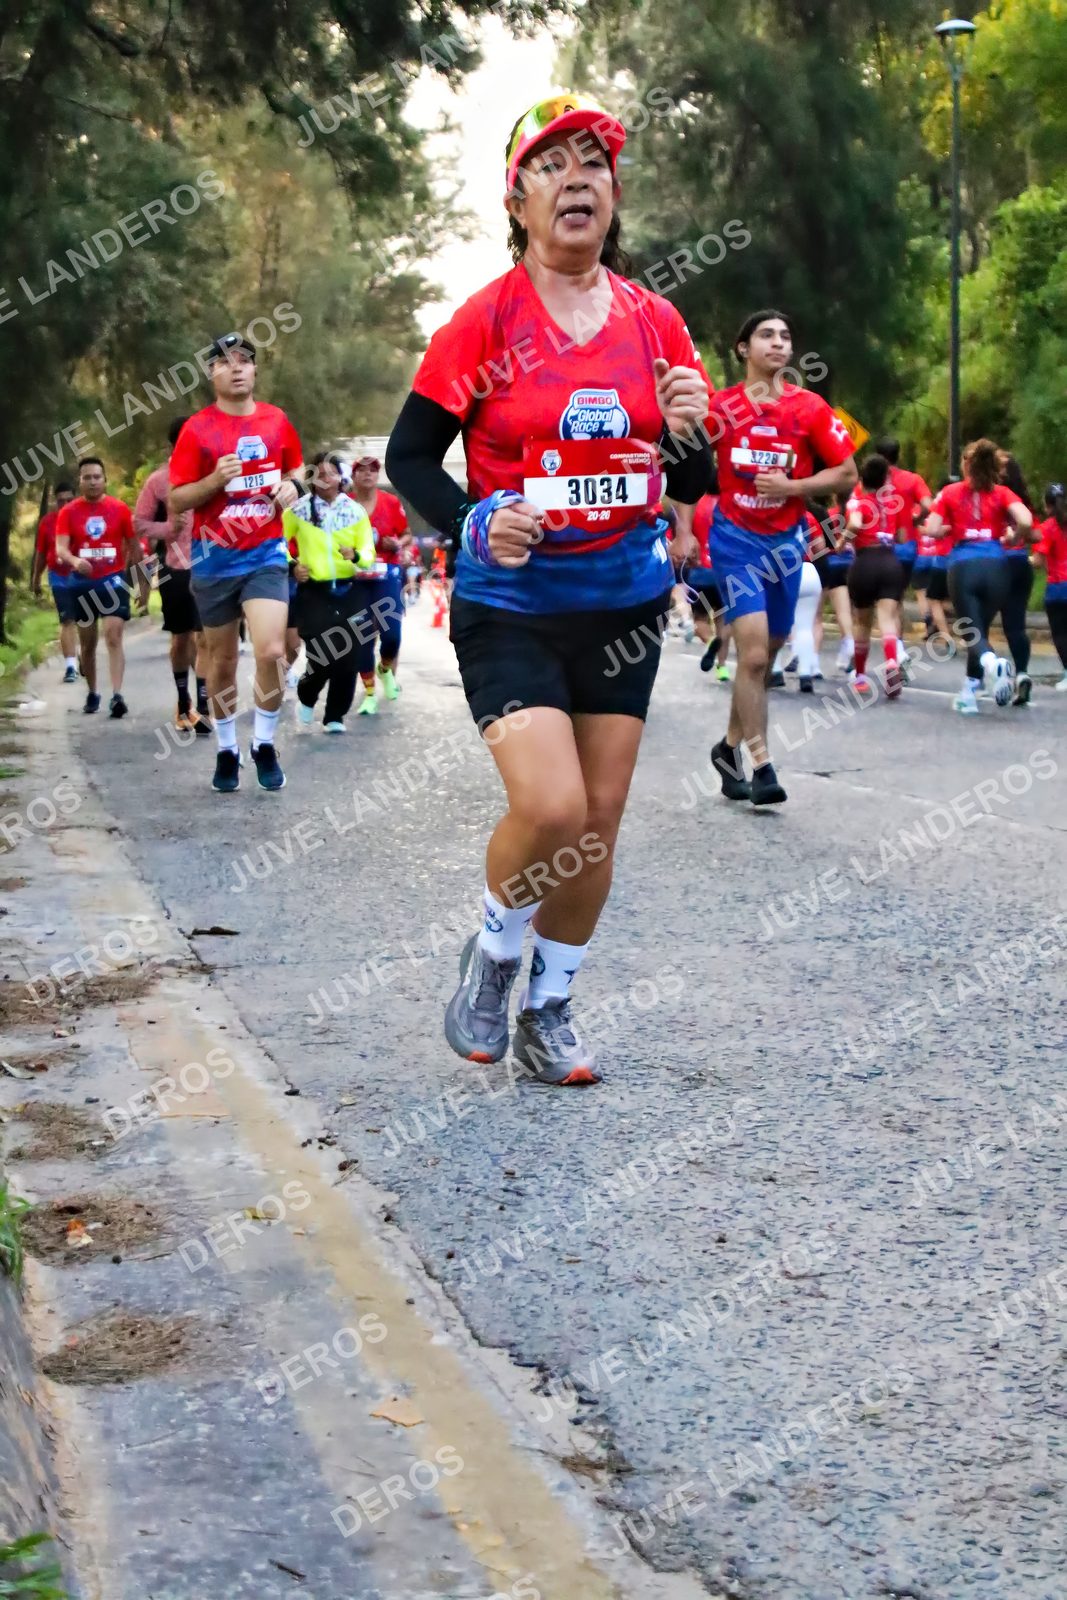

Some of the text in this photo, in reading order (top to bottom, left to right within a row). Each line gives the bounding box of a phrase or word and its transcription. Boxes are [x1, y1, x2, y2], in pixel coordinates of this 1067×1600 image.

[577, 396, 613, 405] BIMBO
[578, 409, 613, 422] Global
[571, 420, 600, 433] Race
[244, 474, 265, 488] 1213
[568, 476, 629, 506] 3034
